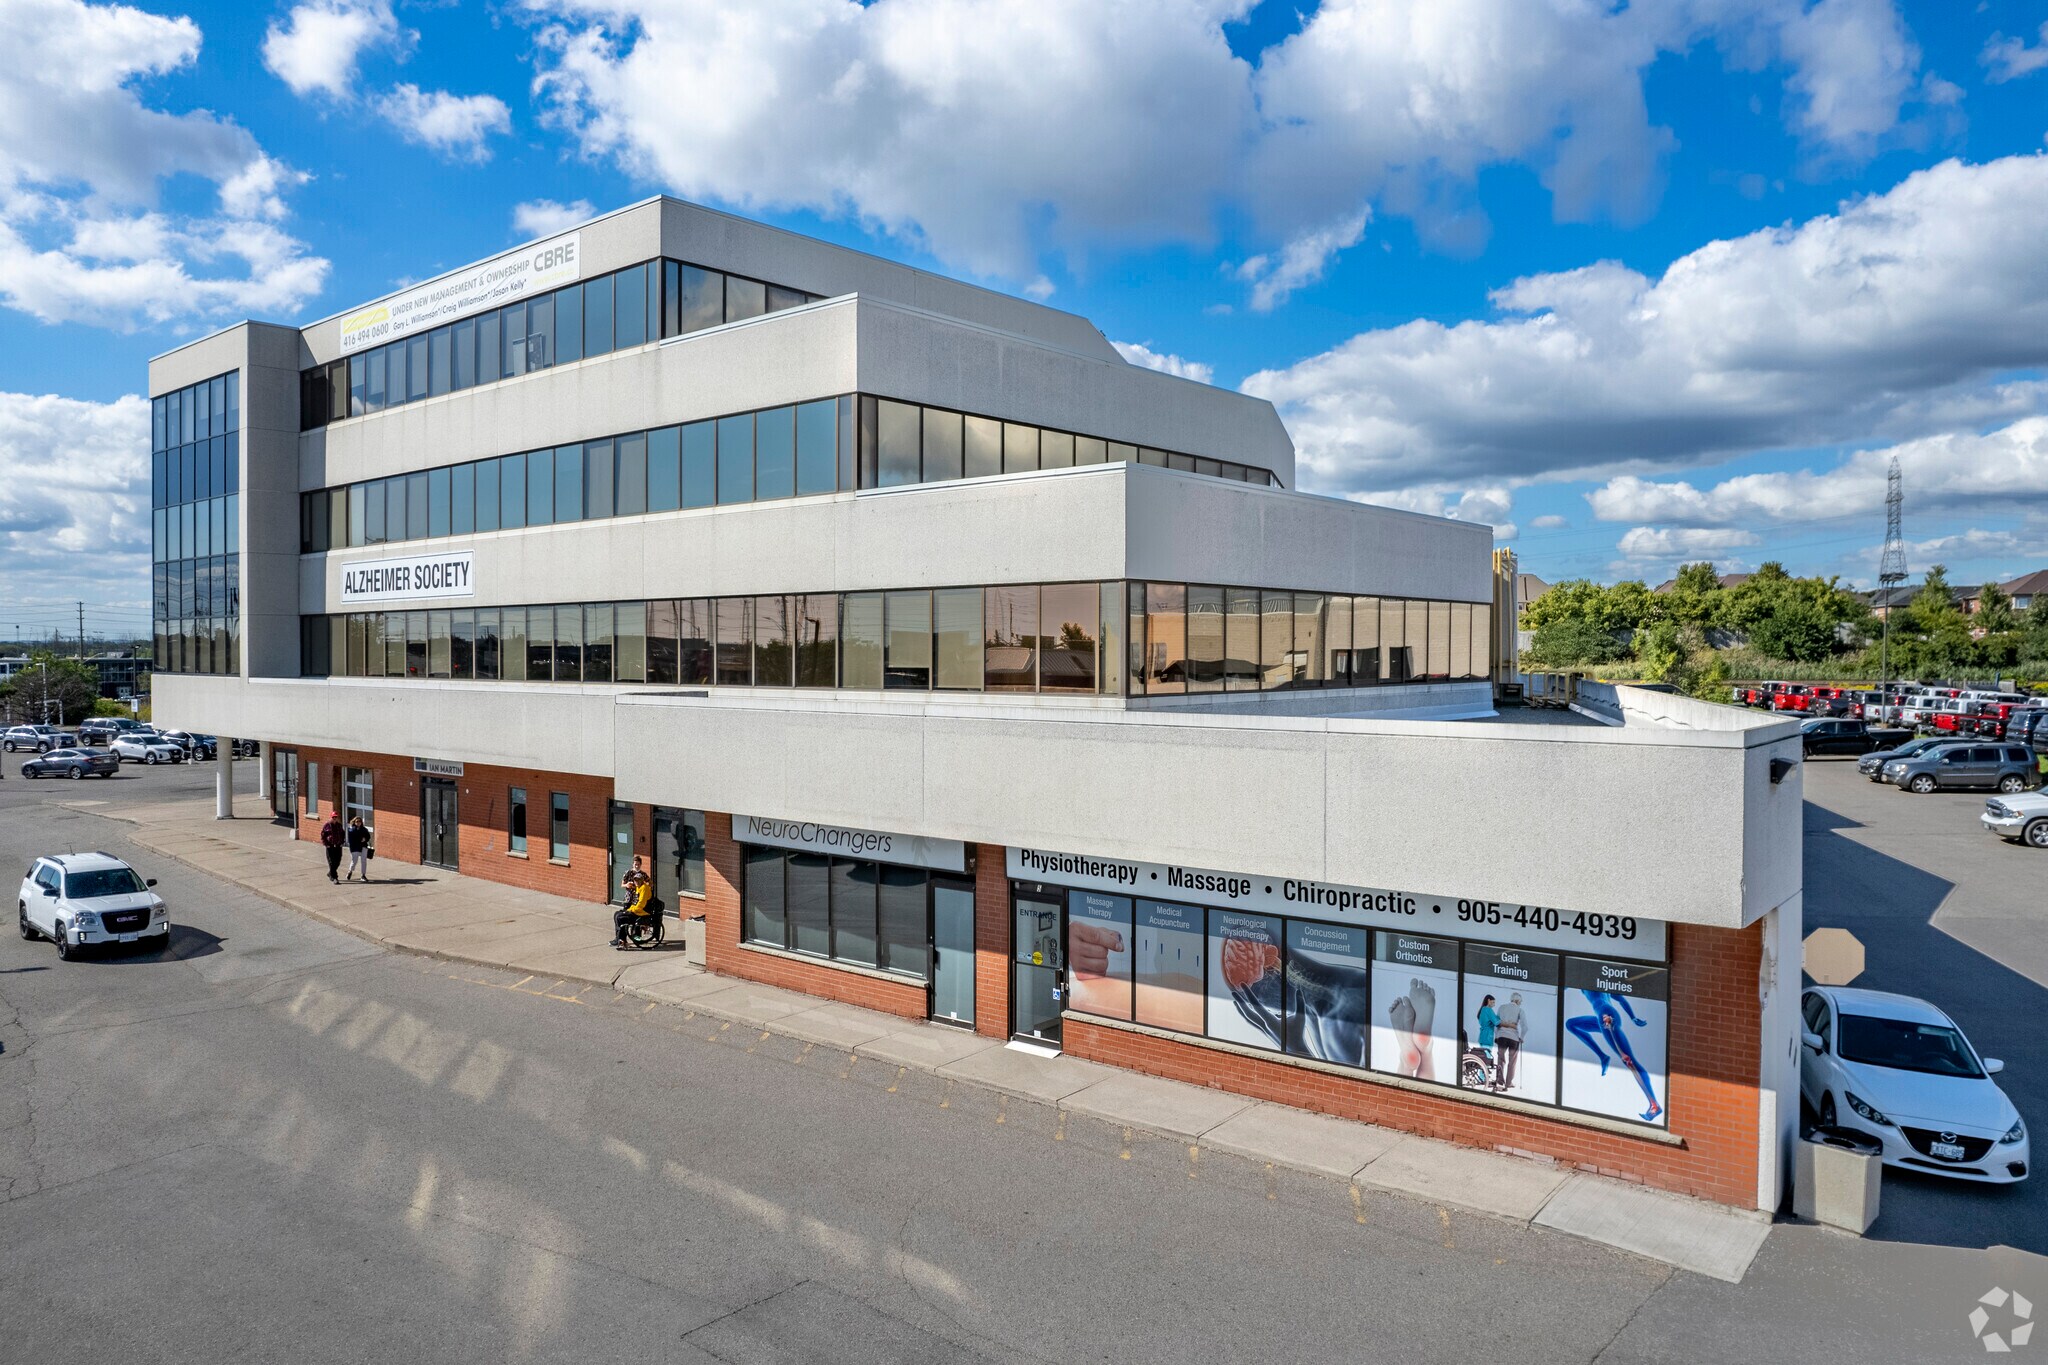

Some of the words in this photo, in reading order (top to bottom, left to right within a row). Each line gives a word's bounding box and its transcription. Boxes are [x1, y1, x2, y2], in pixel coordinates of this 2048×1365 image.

[534, 242, 574, 272] CBRE
[392, 302, 413, 317] UNDER
[414, 296, 428, 311] NEW
[430, 278, 477, 302] MANAGEMENT
[479, 276, 484, 287] &
[487, 259, 530, 284] OWNERSHIP
[392, 320, 405, 331] Gary
[343, 334, 356, 348] 416
[357, 328, 370, 343] 494
[372, 322, 389, 338] 0600
[344, 566, 410, 594] ALZHEIMER
[414, 561, 470, 590] SOCIETY
[429, 763, 439, 772] IAN
[440, 765, 462, 775] MARTIN
[748, 816, 892, 854] NeuroChangers
[1021, 849, 1138, 885] Physiotherapy
[1168, 867, 1251, 899] Massage
[1283, 880, 1416, 916] Chiropractic
[1457, 899, 1637, 941] 905-440-4939
[1086, 896, 1113, 908] Massage
[1019, 908, 1057, 921] ENTRANCE
[1087, 906, 1112, 919] Therapy
[1156, 905, 1182, 917] Medical
[1149, 914, 1190, 930] Acupuncture
[1222, 915, 1266, 929] Neurological
[1220, 925, 1269, 943] Physiotherapy
[1304, 926, 1348, 940] Concussion
[1300, 937, 1350, 953] Management
[1398, 938, 1430, 952] Custom
[1395, 949, 1433, 964] Orthotics
[1501, 952, 1519, 964] Gait
[1493, 963, 1528, 979] Training
[1601, 965, 1628, 979] Sport
[1596, 978, 1633, 993] Injuries
